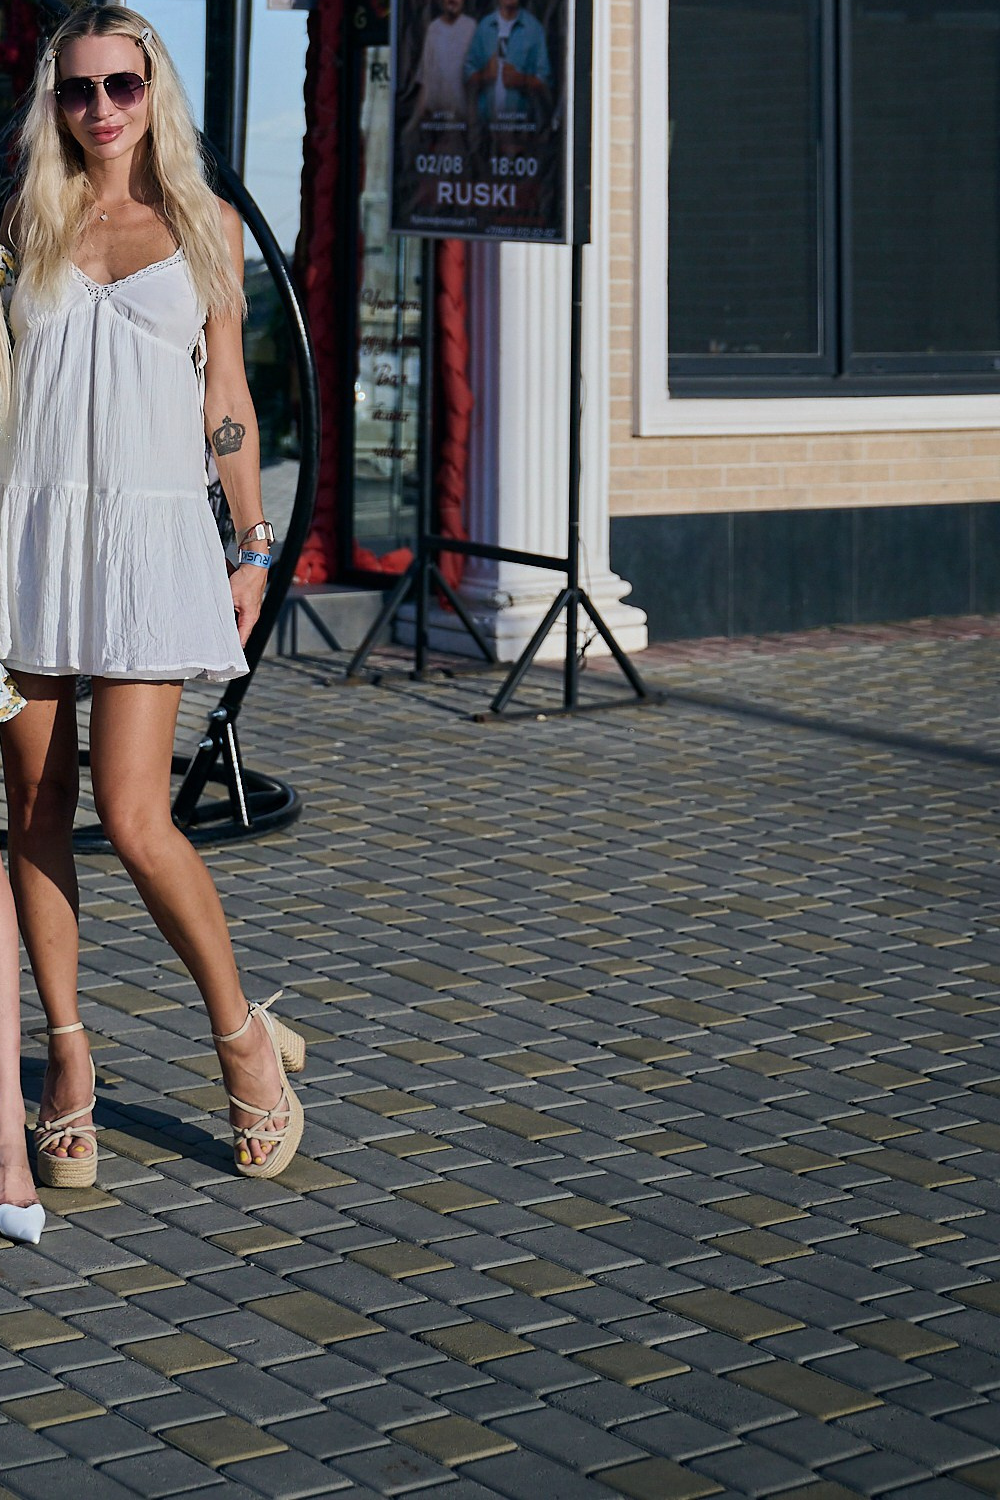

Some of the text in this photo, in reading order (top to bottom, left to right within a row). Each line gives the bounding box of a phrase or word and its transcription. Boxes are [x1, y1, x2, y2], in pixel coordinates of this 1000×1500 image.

[415, 153, 538, 177] 02/08 18:00
[436, 181, 517, 207] RUSKI
